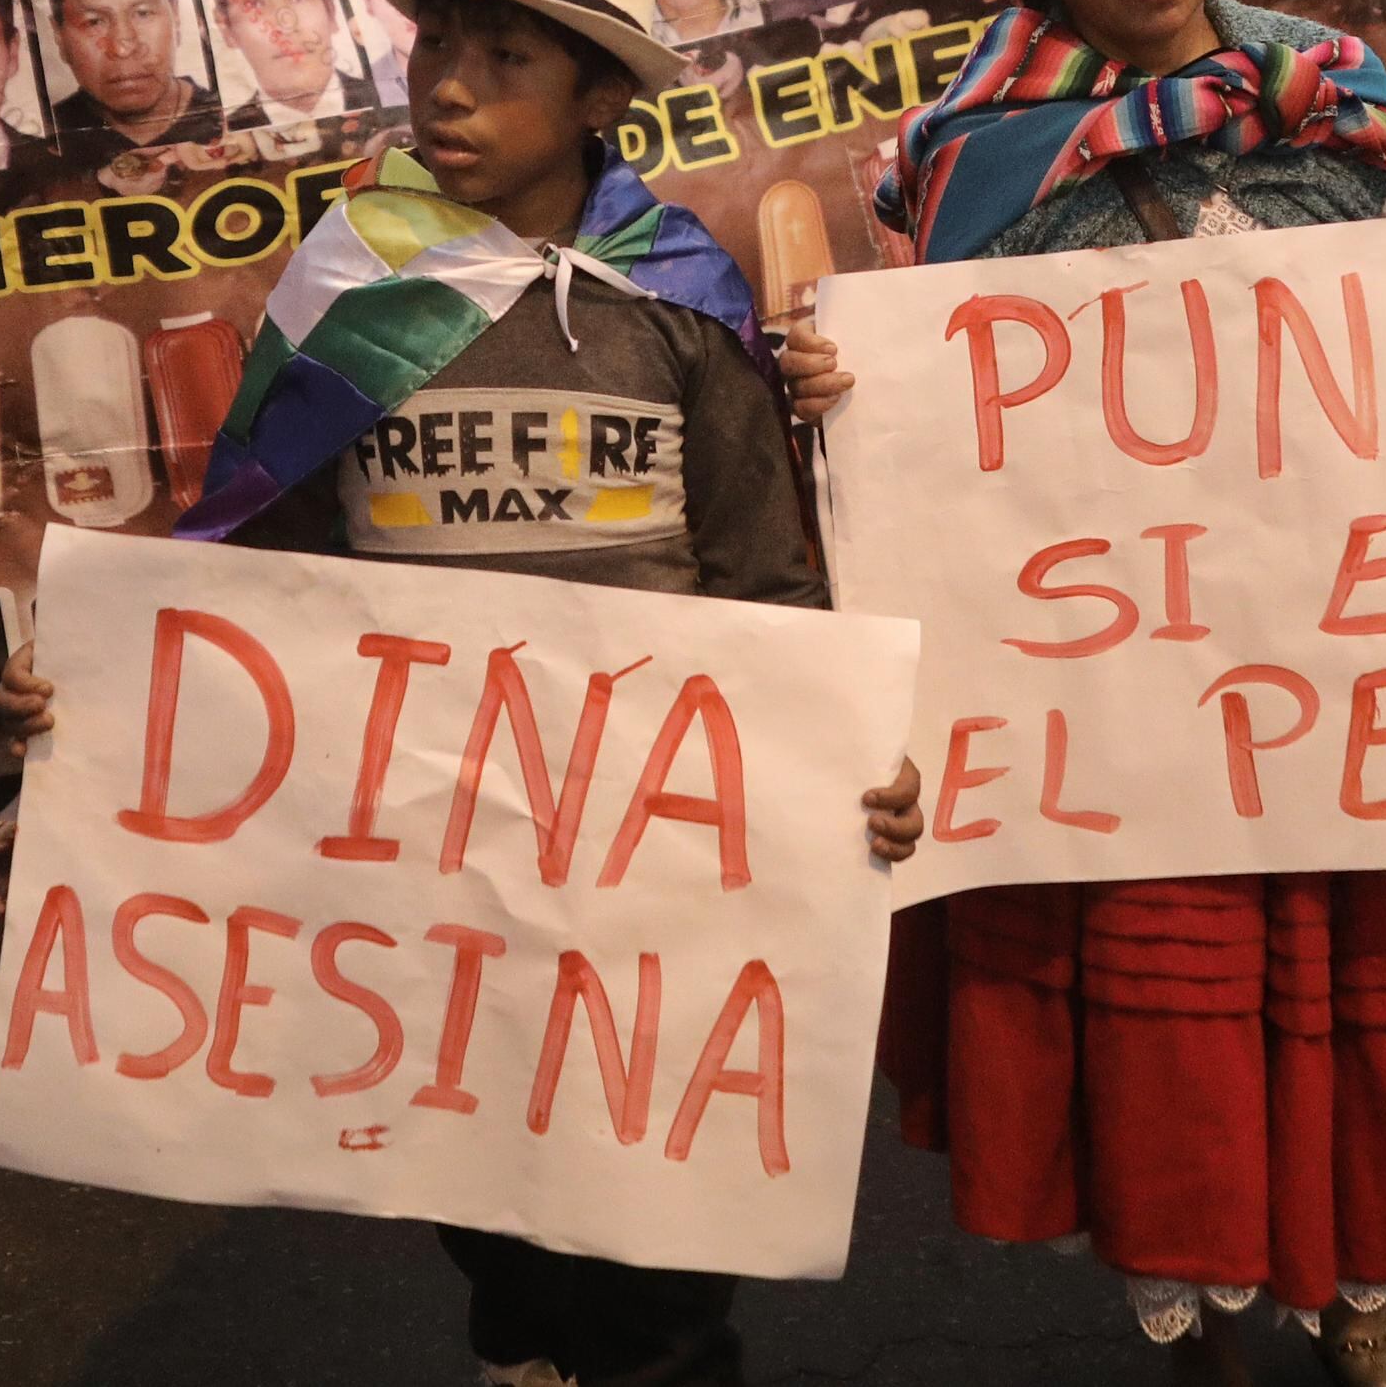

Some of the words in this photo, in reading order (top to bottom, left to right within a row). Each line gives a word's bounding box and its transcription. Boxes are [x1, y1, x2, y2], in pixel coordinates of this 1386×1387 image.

[752, 17, 1001, 150] ENE
[355, 410, 495, 484] FREE
[439, 488, 574, 525] MAX
[1000, 524, 1213, 659] SI
[116, 608, 752, 892] DINA
[932, 709, 1122, 843] EL
[1, 885, 791, 1179] ASESINA
